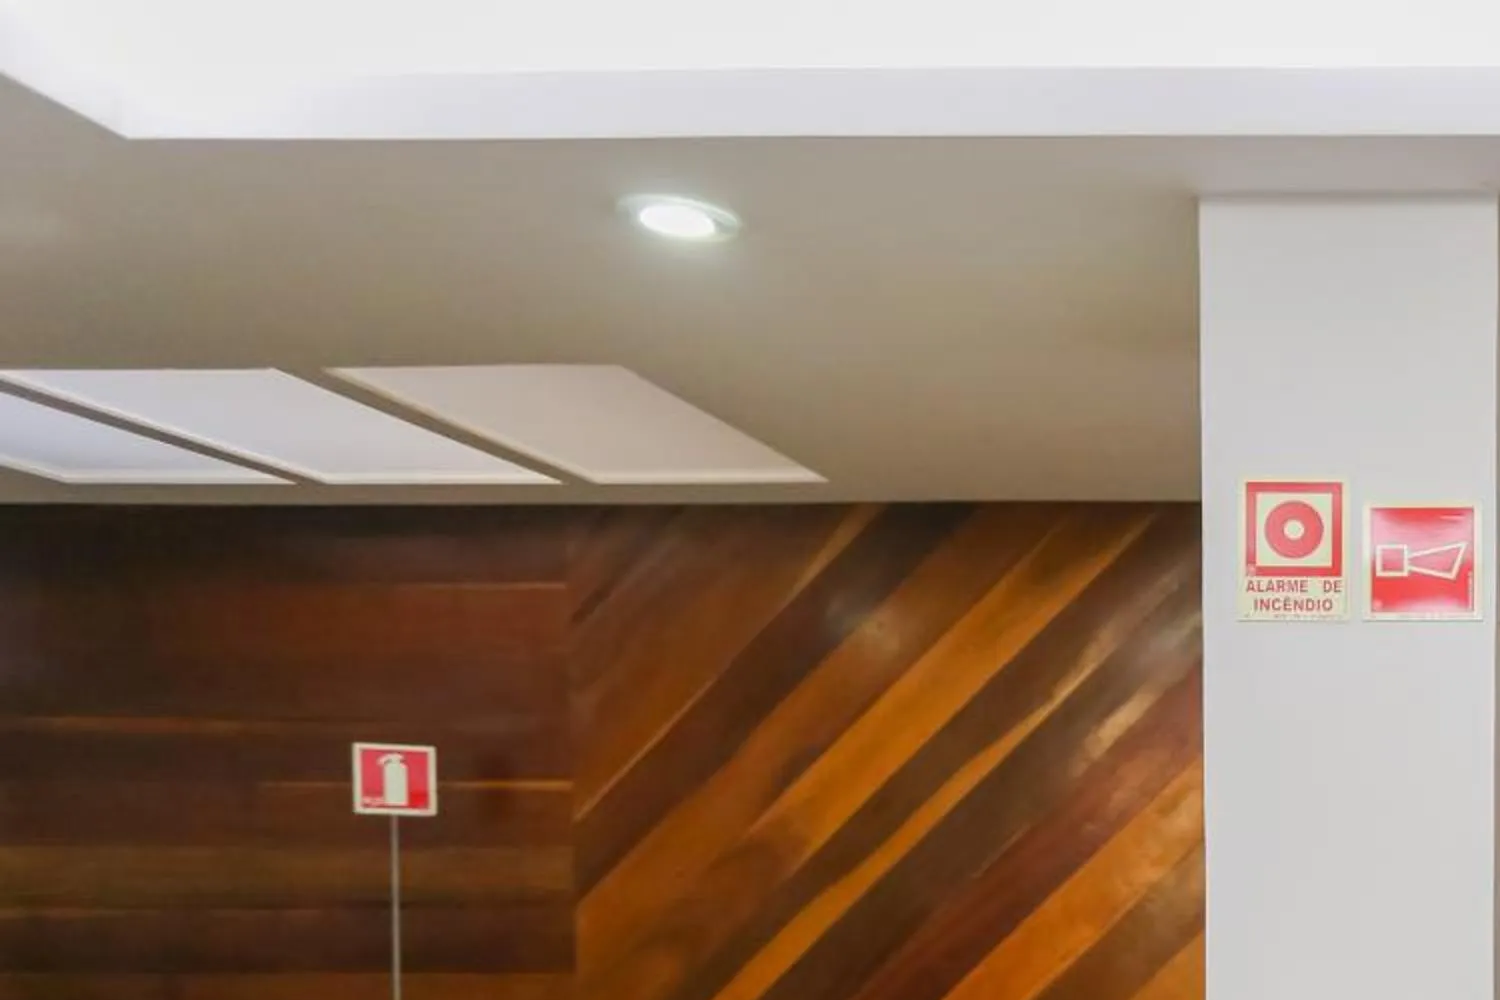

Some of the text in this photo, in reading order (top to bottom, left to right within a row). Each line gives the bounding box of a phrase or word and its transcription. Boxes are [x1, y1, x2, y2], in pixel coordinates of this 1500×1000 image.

[1245, 580, 1342, 593] ALARME DE
[1253, 596, 1333, 611] INCÊNDIO
